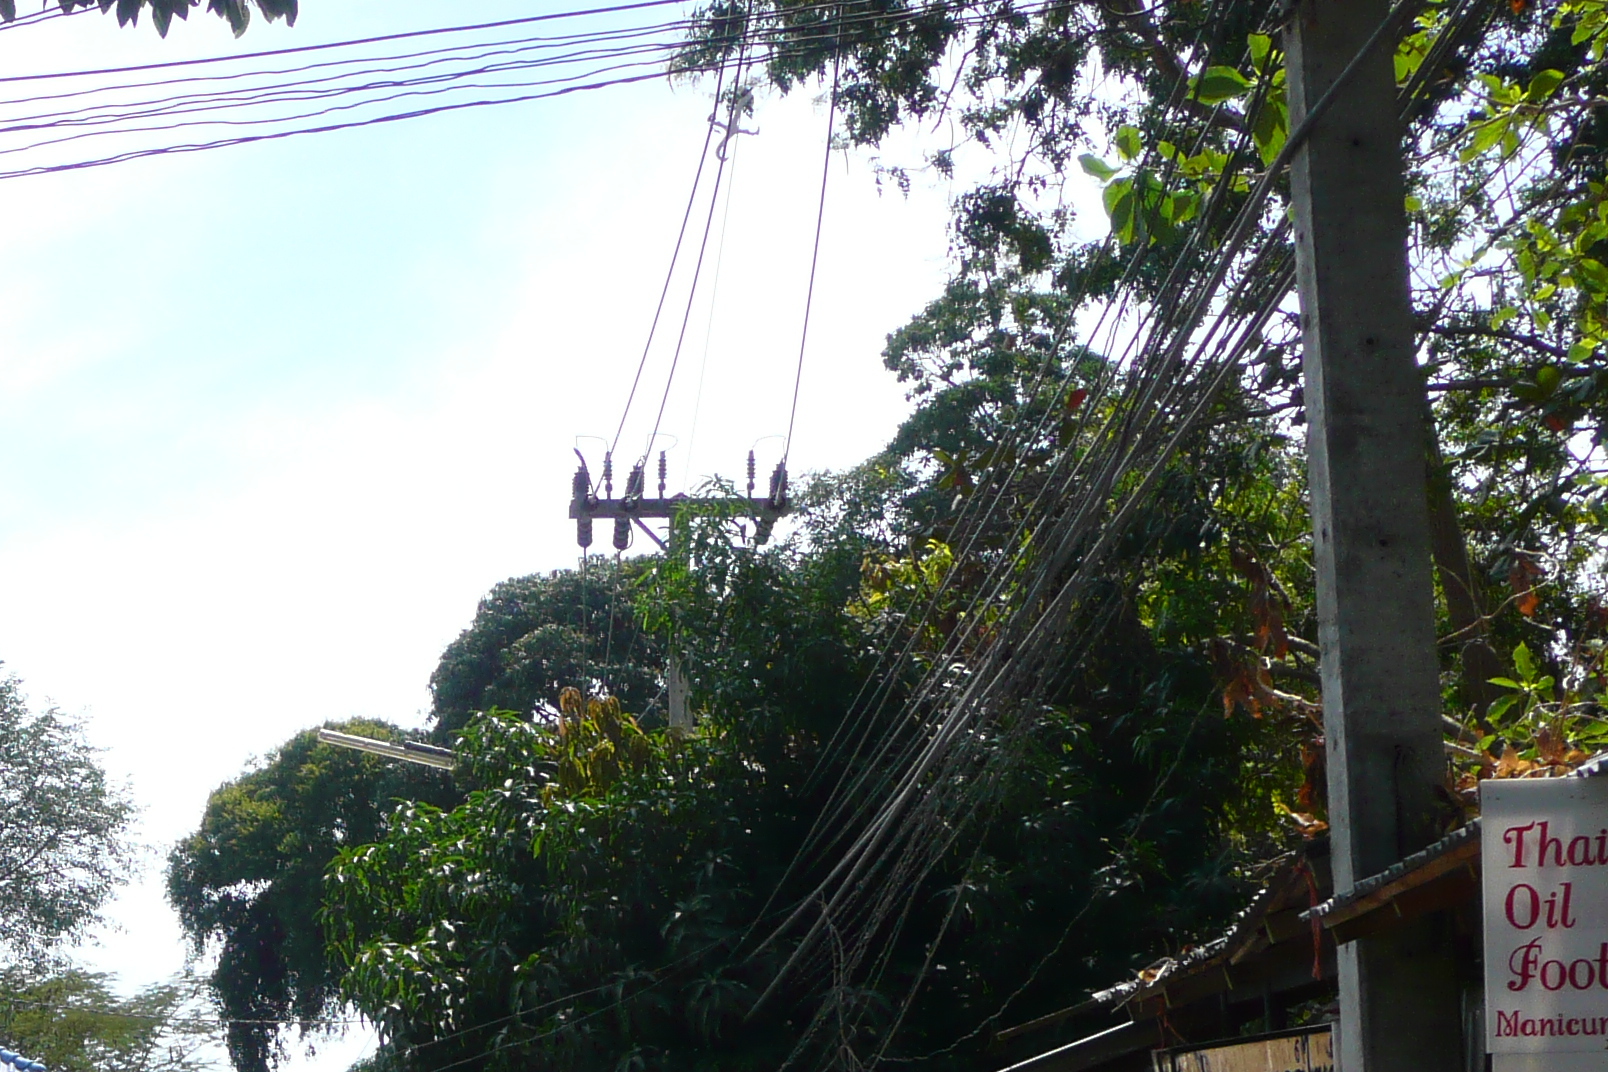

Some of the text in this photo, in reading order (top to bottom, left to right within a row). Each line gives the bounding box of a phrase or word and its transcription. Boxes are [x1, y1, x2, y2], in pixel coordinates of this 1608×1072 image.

[1502, 819, 1608, 869] Thai
[1504, 881, 1576, 930] Oil
[1506, 936, 1608, 992] Foot
